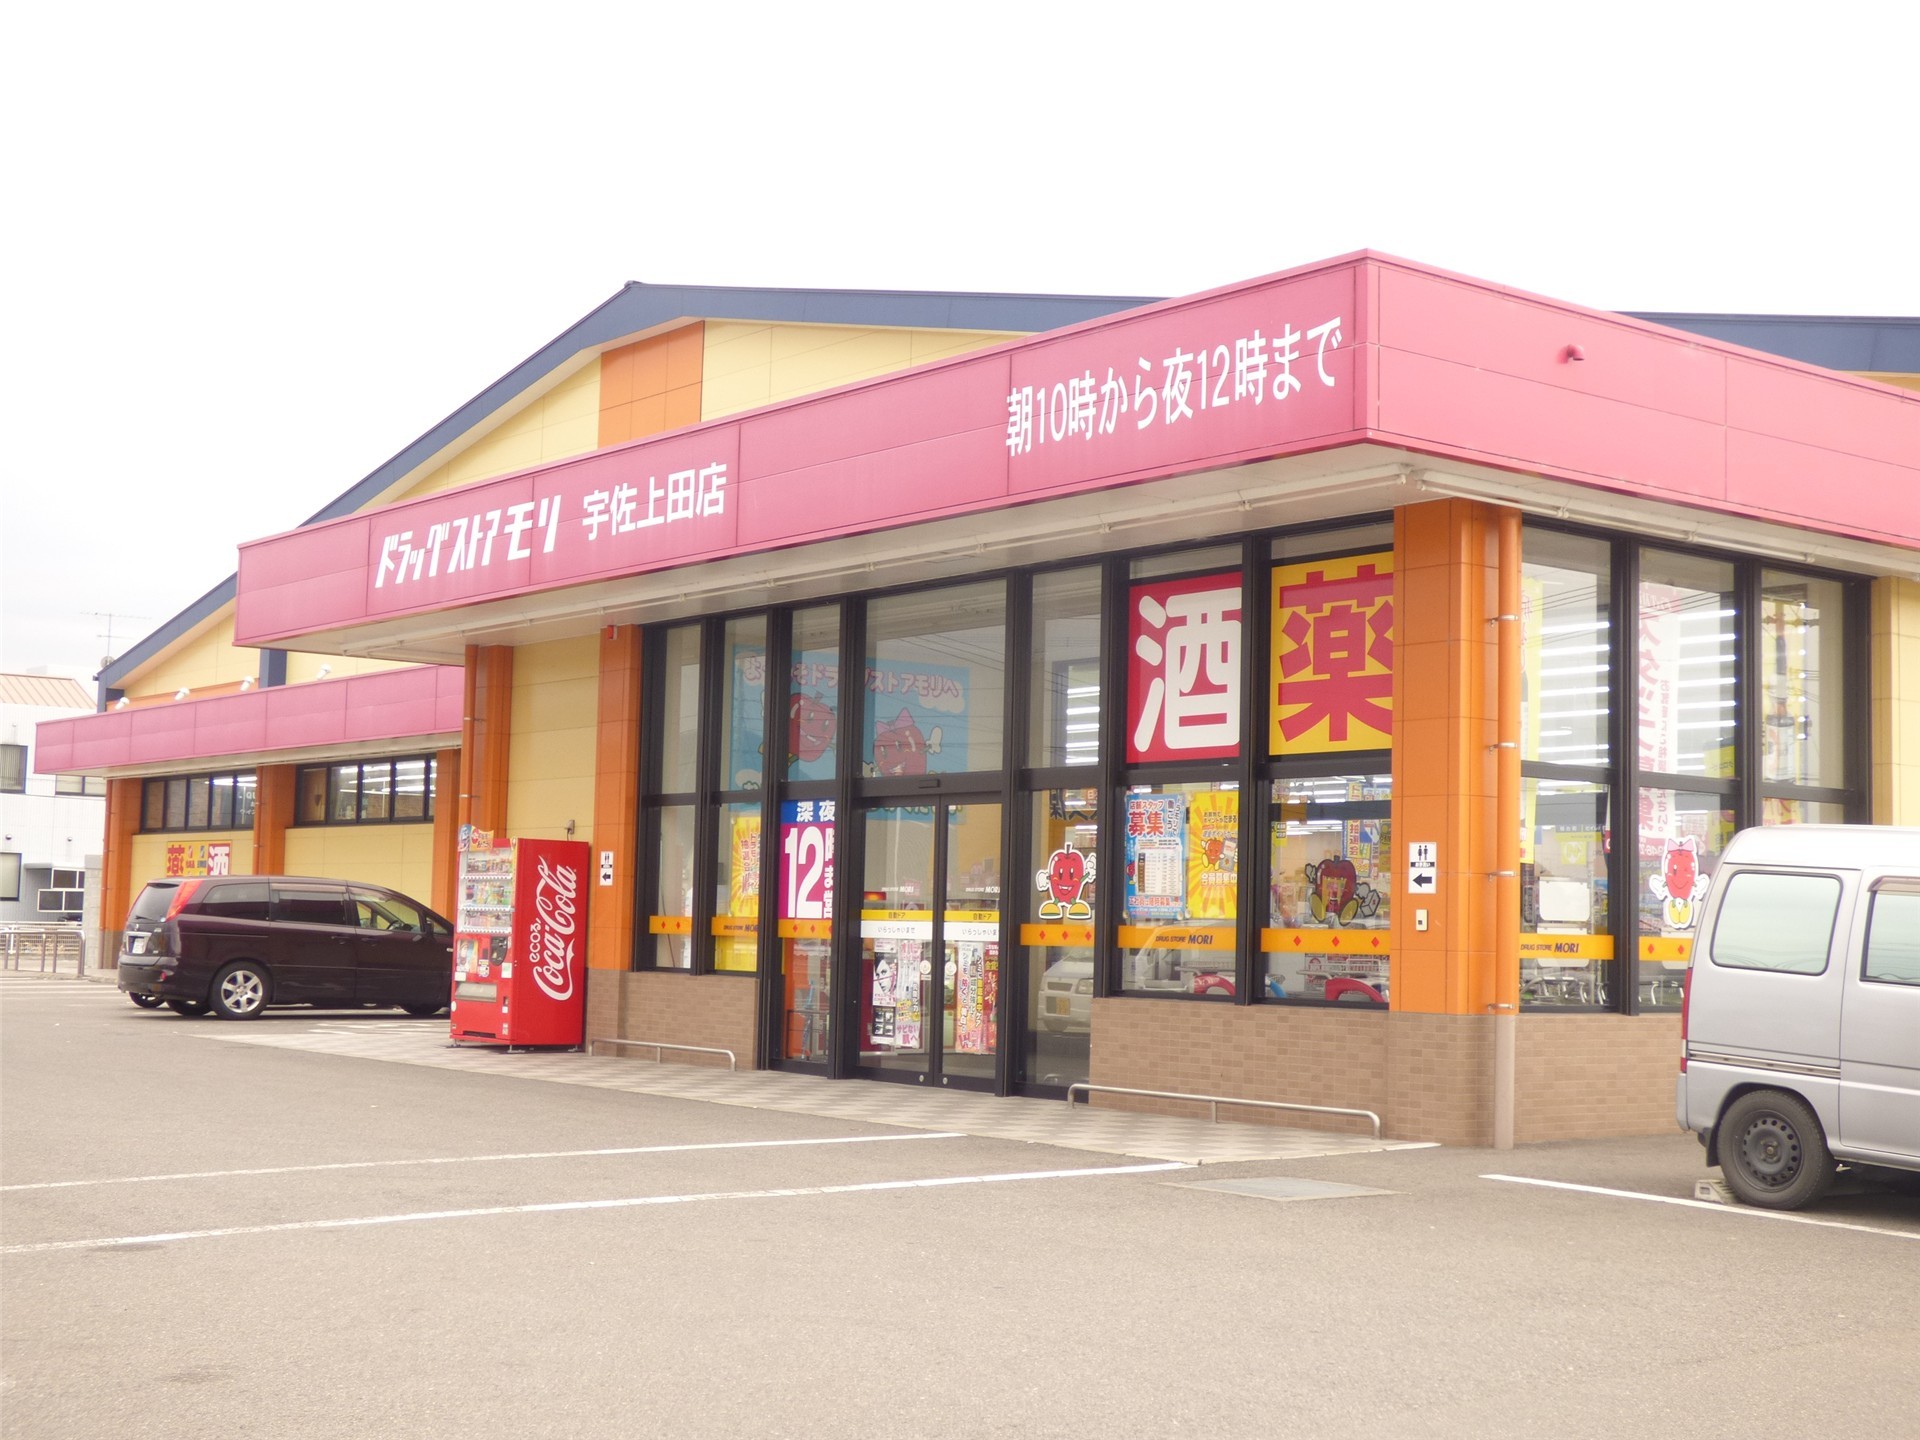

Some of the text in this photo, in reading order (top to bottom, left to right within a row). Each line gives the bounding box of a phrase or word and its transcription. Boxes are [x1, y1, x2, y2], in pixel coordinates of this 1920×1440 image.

[1005, 316, 1343, 457] 朝10時から夜12時まで
[374, 462, 727, 589] ドラッグストアモリ 宇佐上田店
[1278, 563, 1394, 742] 薬
[1134, 587, 1243, 753] 酒
[796, 801, 835, 822] 深夜
[1128, 811, 1164, 837] 募集
[785, 826, 824, 918] 12
[533, 855, 577, 1001] Coca-Cola
[973, 912, 992, 920] 自動ドア
[877, 926, 915, 934] いらっしゃいませ
[962, 928, 999, 936] いらっしゃいま
[1187, 935, 1213, 945] MORI
[1554, 942, 1579, 953] MORI
